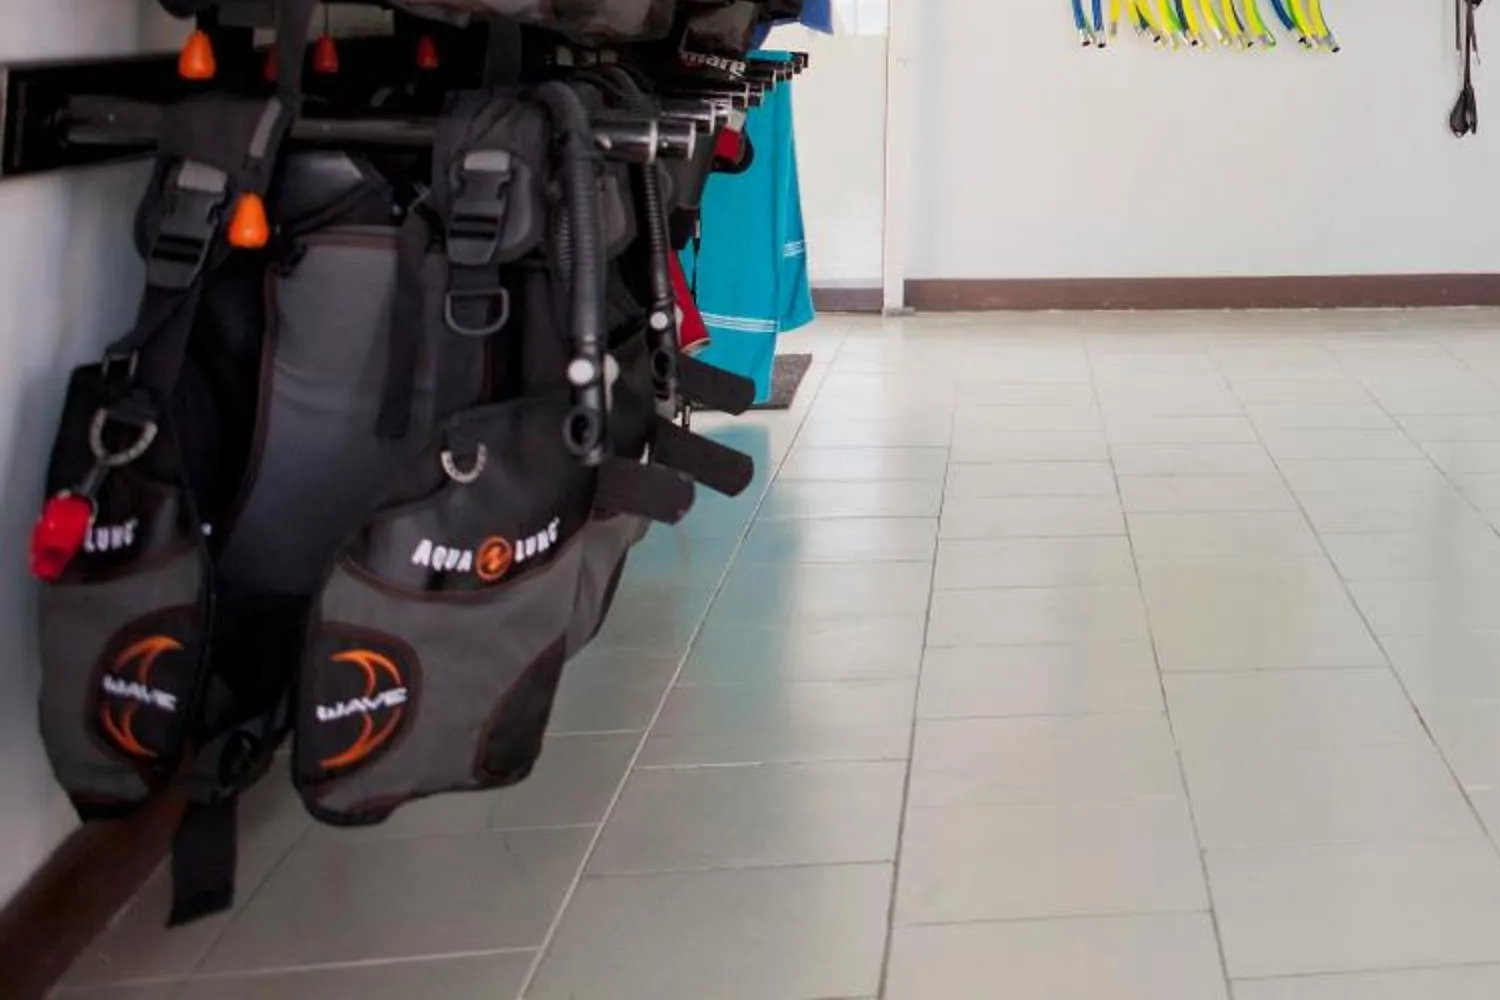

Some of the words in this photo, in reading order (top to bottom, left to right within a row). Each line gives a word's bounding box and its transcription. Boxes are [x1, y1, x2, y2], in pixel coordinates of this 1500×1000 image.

[680, 51, 747, 77] mare
[411, 538, 473, 572] AQUA
[515, 519, 559, 562] LUNG
[103, 673, 177, 713] WAVE
[316, 687, 408, 722] WAVE
